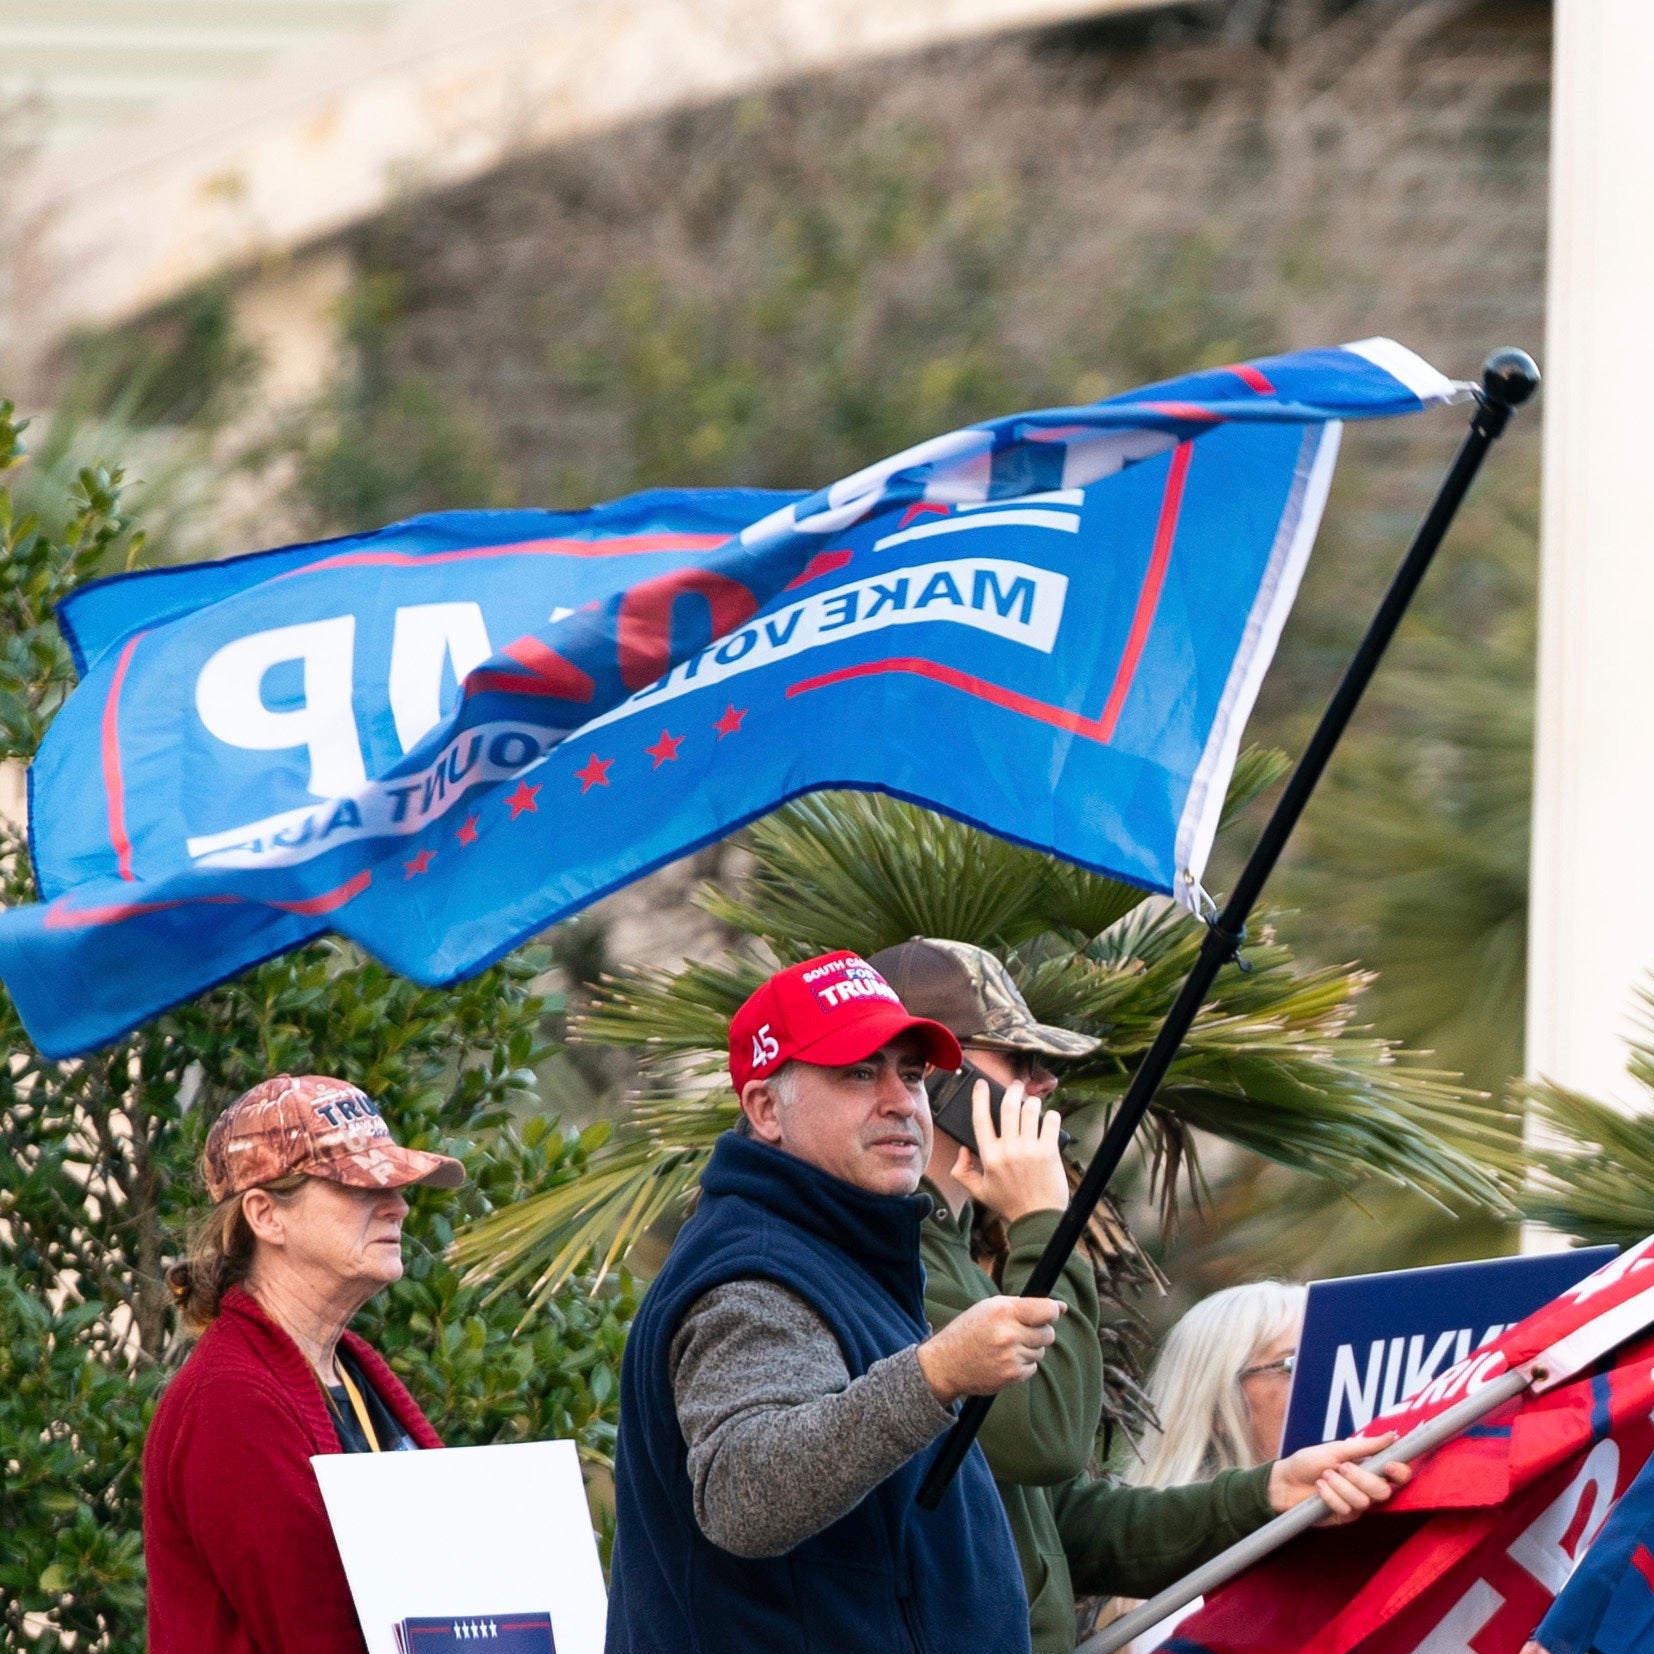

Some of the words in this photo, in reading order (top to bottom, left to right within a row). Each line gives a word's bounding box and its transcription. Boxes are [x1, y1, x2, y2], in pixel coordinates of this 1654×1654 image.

[802, 959, 846, 983] SOUTH
[845, 968, 876, 980] FOR
[818, 978, 900, 1006] TRUM
[752, 1023, 780, 1068] 45
[314, 1094, 381, 1129] TRU
